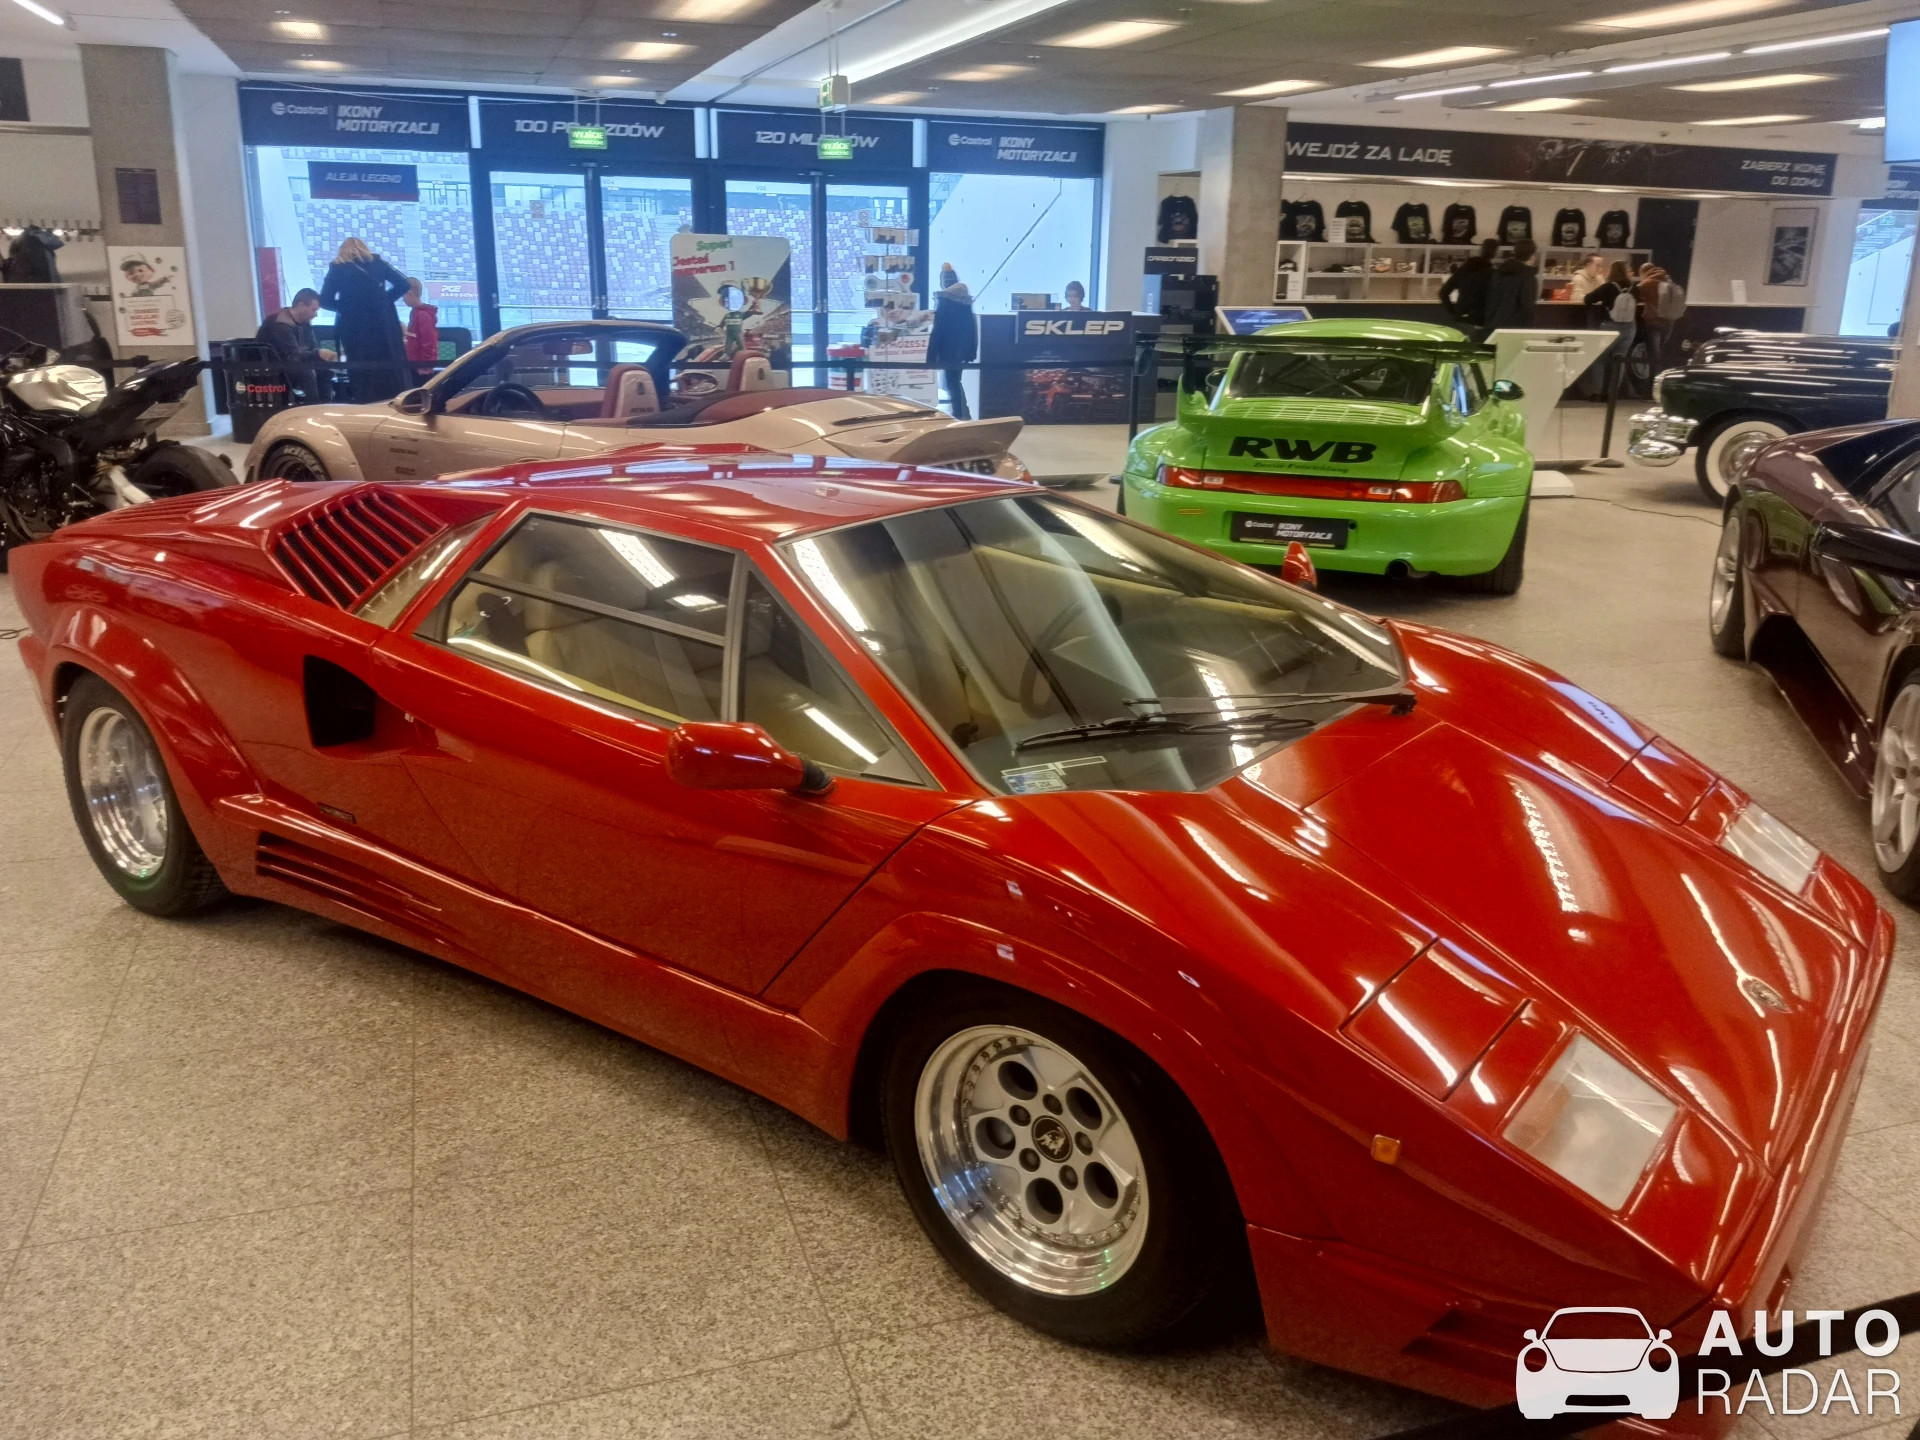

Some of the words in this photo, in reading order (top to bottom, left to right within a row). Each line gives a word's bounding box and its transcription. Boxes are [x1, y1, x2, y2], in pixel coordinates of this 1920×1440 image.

[286, 104, 329, 116] Castrol
[337, 104, 383, 118] IKONY
[336, 119, 440, 135] MOTORYZACJI
[514, 119, 548, 133] 100
[755, 130, 786, 144] 120
[960, 136, 993, 146] Castrol
[1000, 137, 1036, 149] IKONY
[997, 149, 1077, 163] MOTORYZACJI
[1286, 142, 1361, 159] WEJDŹ
[1364, 145, 1392, 161] ZA
[1397, 148, 1453, 166] LADĘ
[1741, 160, 1791, 172] ZABIERZ
[326, 172, 359, 182] ALEJA
[360, 174, 402, 184] LEGEND
[1771, 175, 1789, 186] DO
[1789, 176, 1825, 188] DOMU
[696, 238, 733, 252] Super!
[729, 260, 735, 271] 1
[1024, 320, 1125, 336] SKLEP
[247, 384, 287, 393] Castrol
[1228, 436, 1377, 463] RWB
[1277, 522, 1303, 531] IKONY
[1275, 530, 1333, 540] MOTORYZACJI
